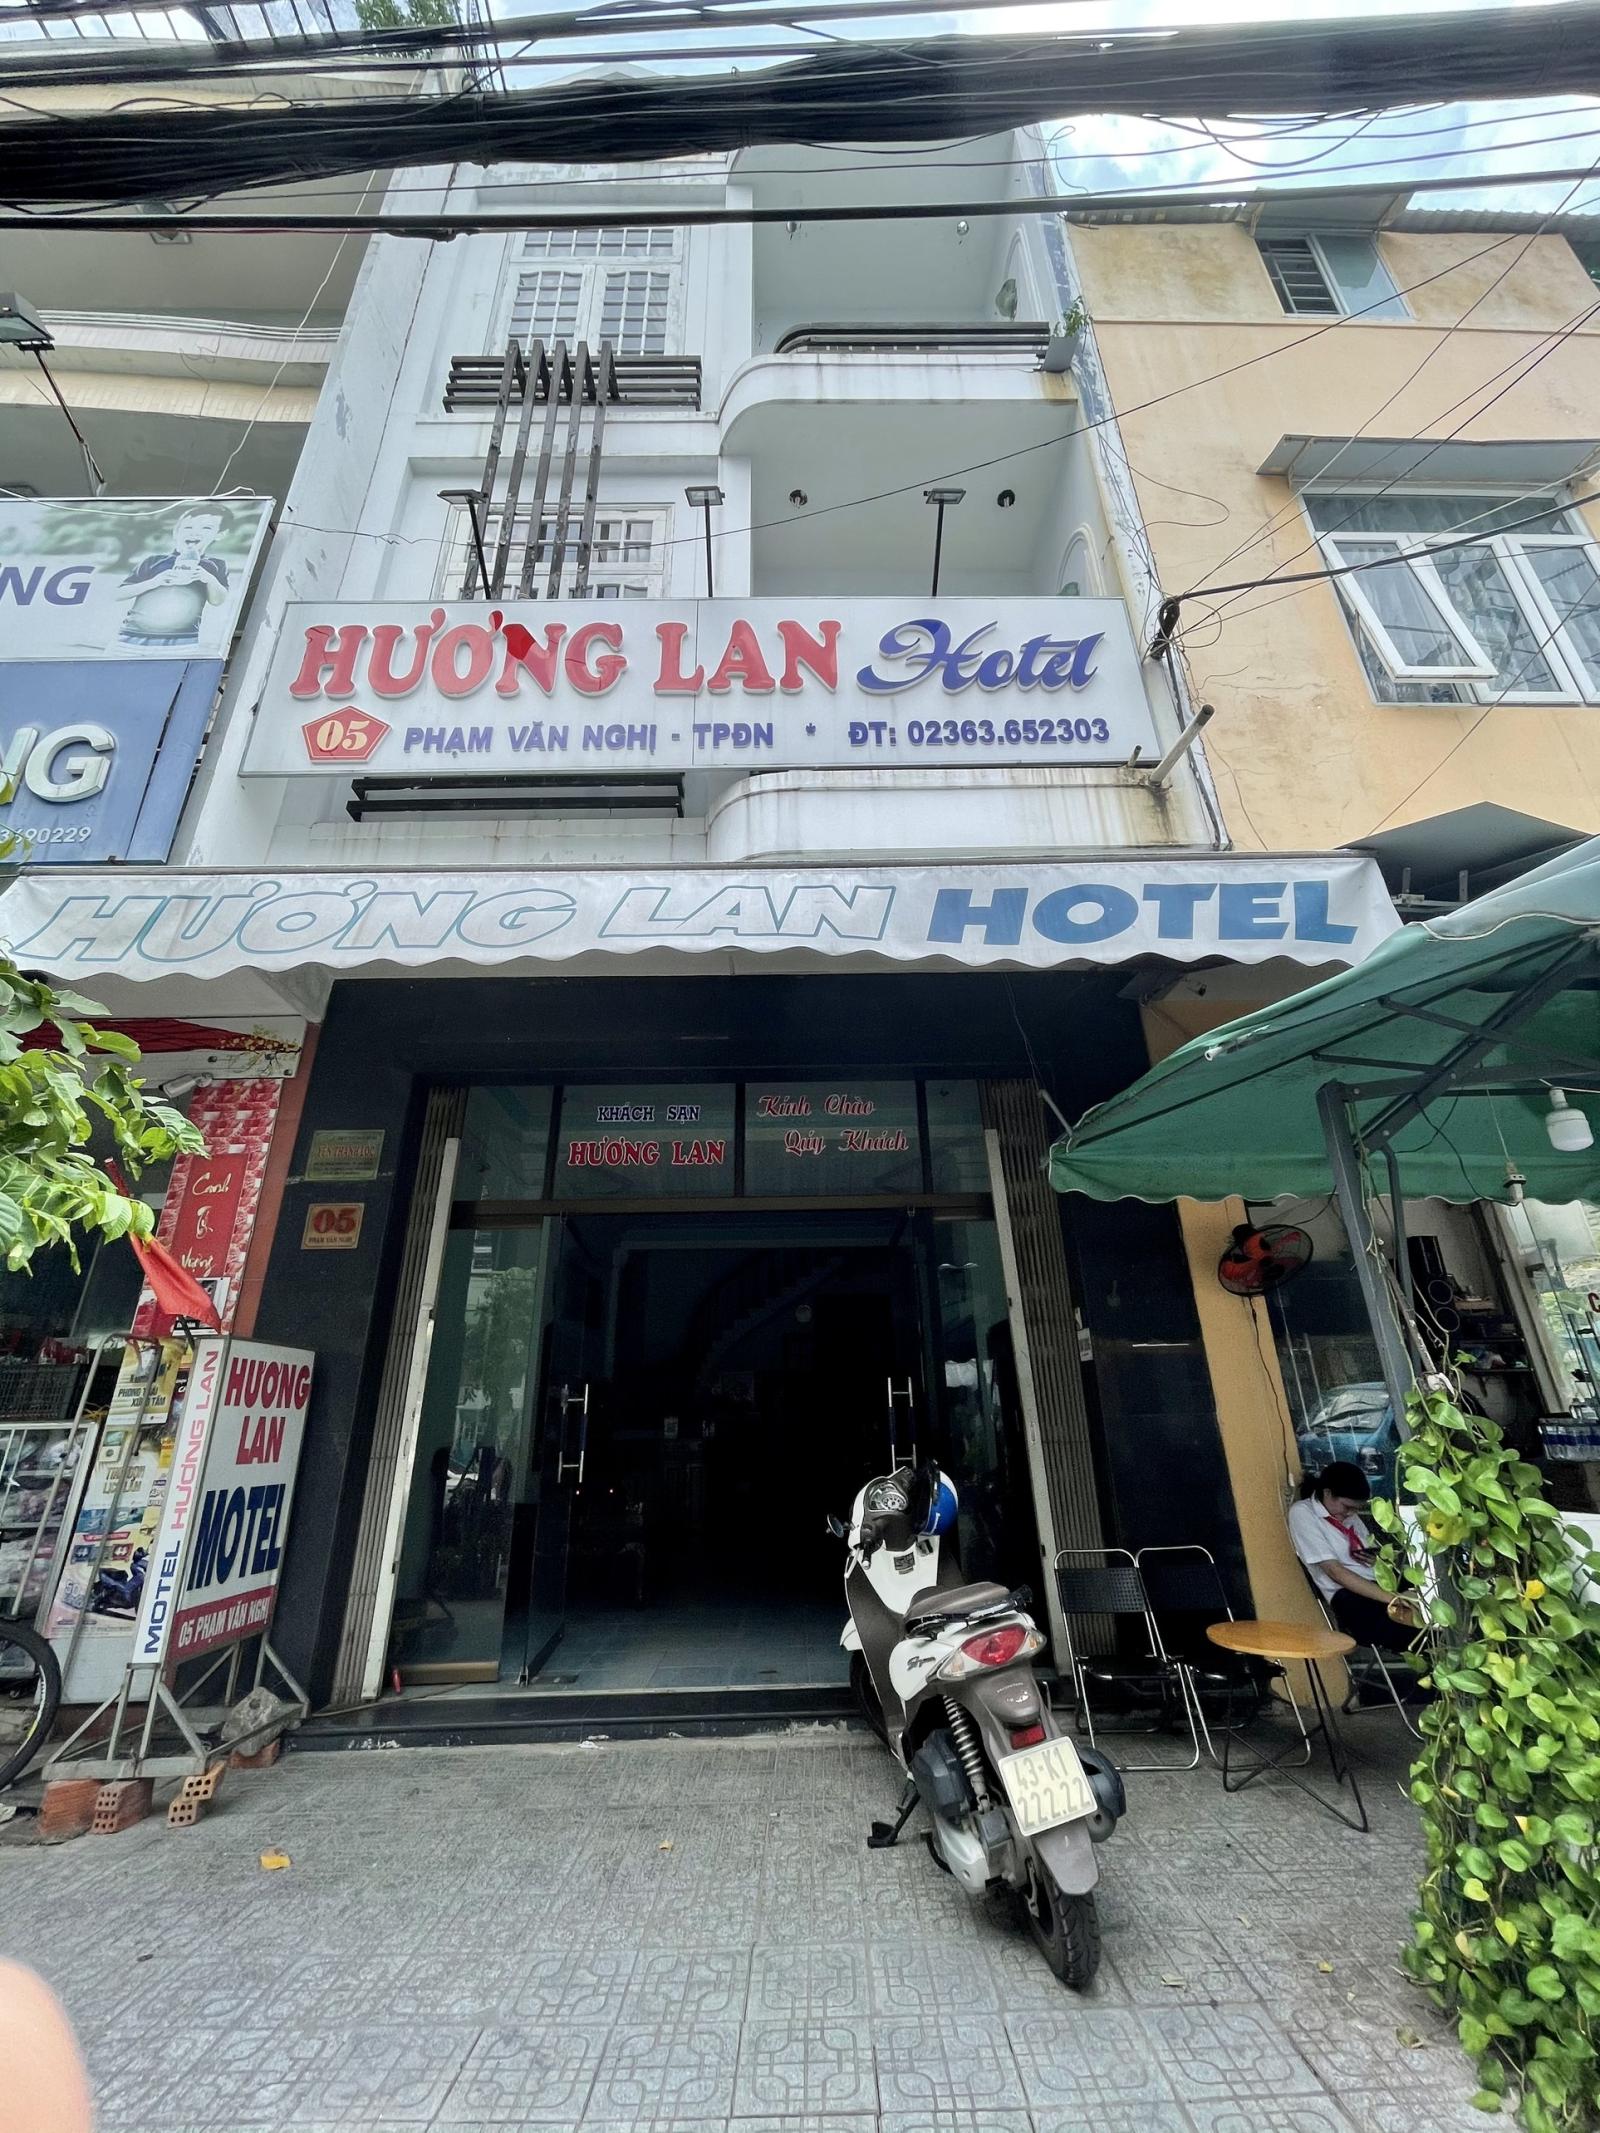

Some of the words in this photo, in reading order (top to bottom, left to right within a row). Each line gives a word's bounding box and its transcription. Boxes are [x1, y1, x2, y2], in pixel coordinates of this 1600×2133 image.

[0, 563, 96, 606] NG
[289, 607, 629, 700] HƯƠNG
[653, 618, 842, 696] LAN
[856, 617, 1107, 696] Hotel
[316, 718, 373, 753] 05
[403, 726, 494, 759] PHẠM
[509, 721, 569, 753] VĂN
[582, 724, 657, 757] NGHỊ
[692, 722, 774, 749] TPĐN
[848, 721, 898, 747] ĐT:
[907, 718, 1110, 747] 02363.652303
[9, 880, 577, 963] HƯƠNG
[599, 884, 896, 940] LAN
[927, 879, 1359, 945] HOTEL
[597, 1101, 655, 1122] KHÁCH
[666, 1105, 701, 1125] SẠN
[757, 1095, 812, 1117] Kính
[824, 1093, 876, 1117] Chào
[567, 1136, 661, 1167] HƯƠNG
[671, 1140, 726, 1166] LAN
[783, 1129, 826, 1157] Quý
[838, 1127, 909, 1153] Khách
[312, 1207, 357, 1234] 05
[224, 1357, 312, 1410] HƯƠNG
[235, 1416, 286, 1466] LAN
[144, 1539, 182, 1654] MOTEL
[195, 1350, 219, 1410] LAN
[187, 1483, 287, 1592] MOTEL
[177, 1619, 195, 1649] 05
[194, 1609, 228, 1644] PHẠM
[227, 1599, 249, 1632] VĂN
[247, 1596, 272, 1625] NGHỊ
